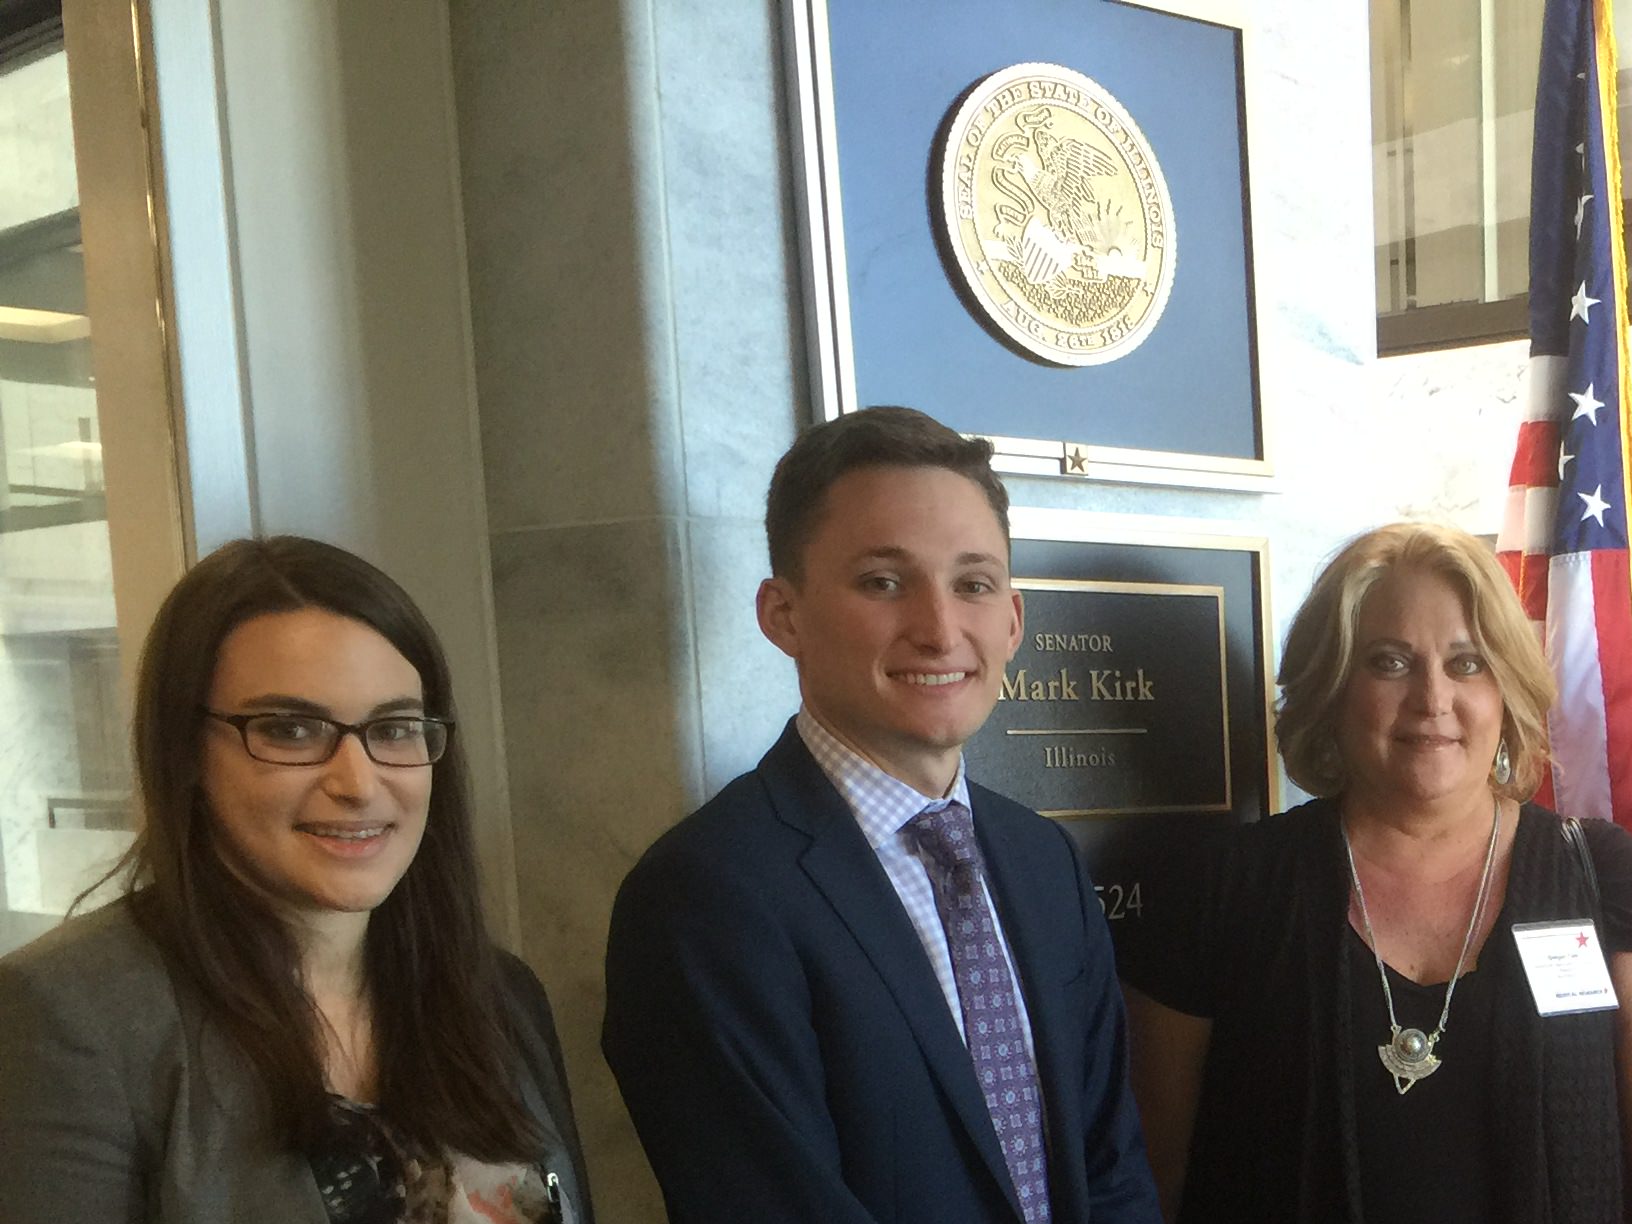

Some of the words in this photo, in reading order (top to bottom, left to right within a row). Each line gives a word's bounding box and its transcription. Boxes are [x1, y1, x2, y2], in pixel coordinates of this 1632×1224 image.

[957, 153, 974, 220] SEAL
[985, 86, 1024, 118] THE
[1028, 80, 1092, 111] STATE
[1094, 100, 1122, 136] OF
[1118, 128, 1165, 250] ILLINOIS
[1035, 633, 1113, 652] SENATOR
[997, 667, 1080, 701] Mark
[1089, 668, 1155, 701] Kirk
[1045, 746, 1117, 768] Illinois
